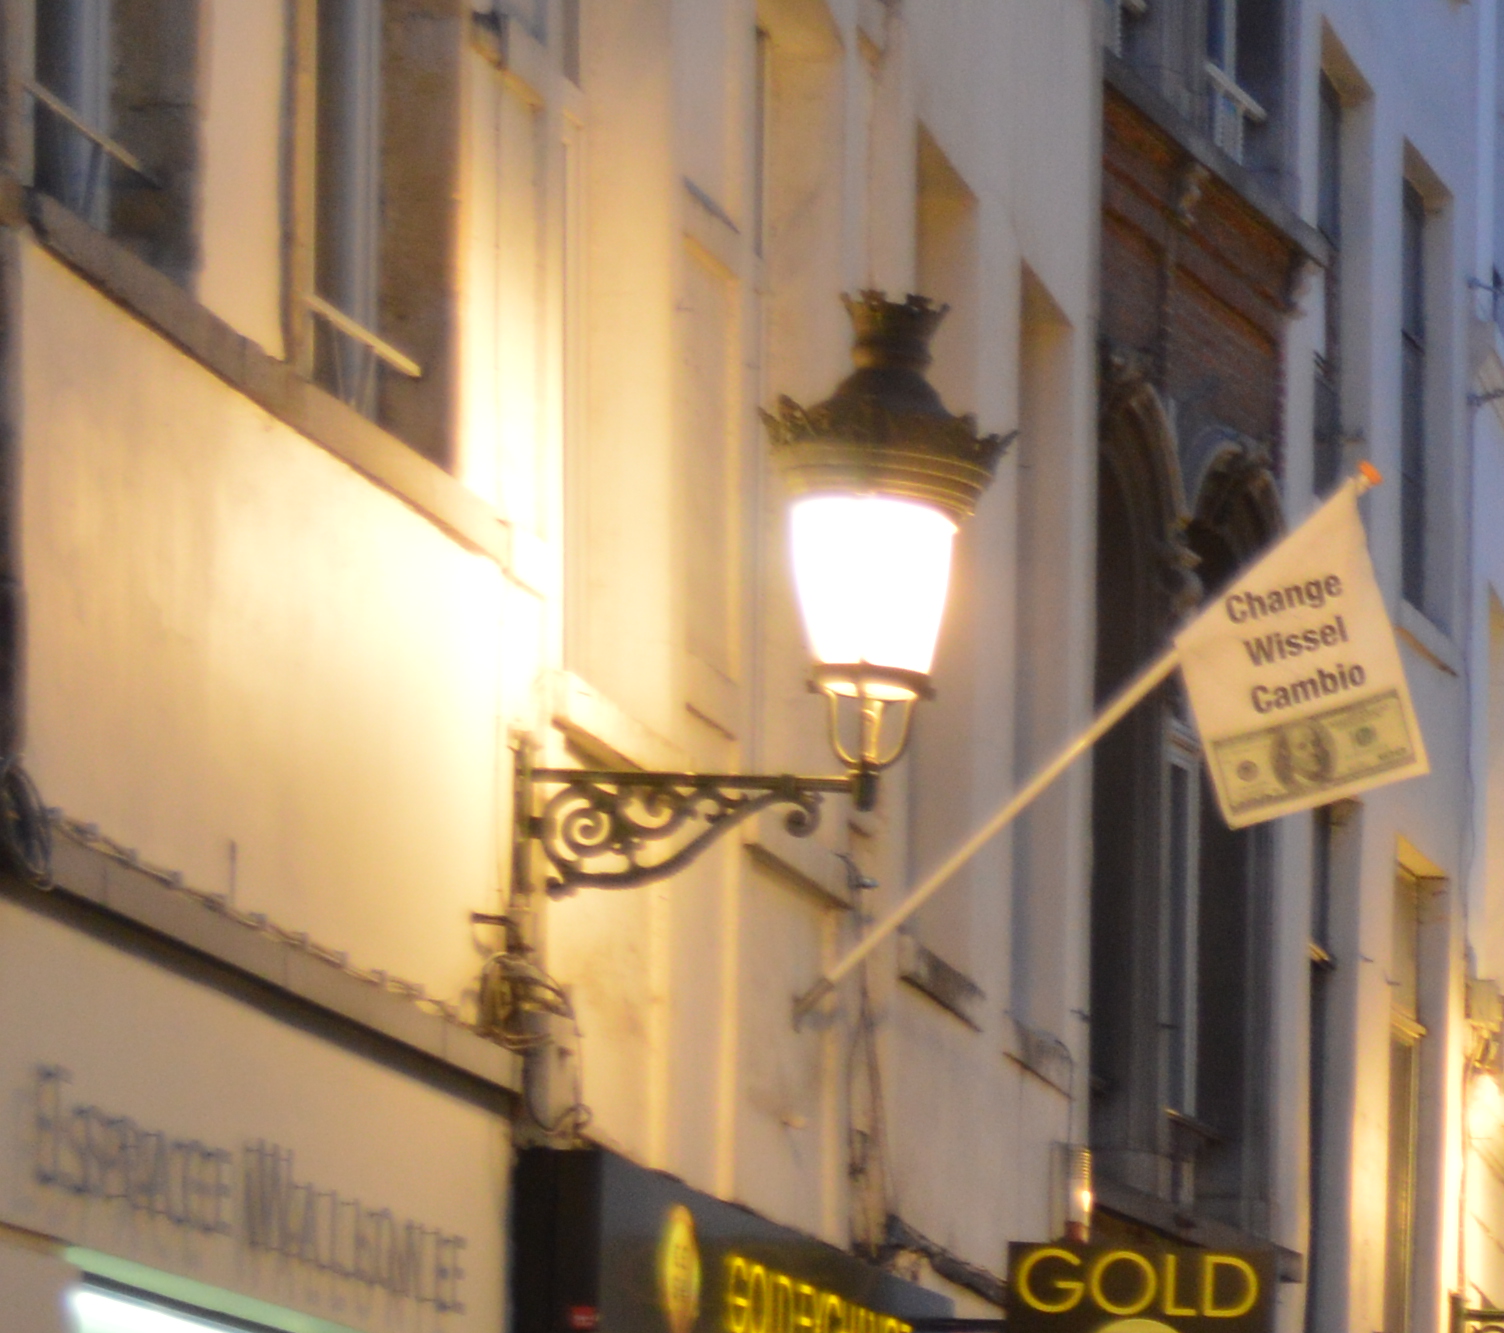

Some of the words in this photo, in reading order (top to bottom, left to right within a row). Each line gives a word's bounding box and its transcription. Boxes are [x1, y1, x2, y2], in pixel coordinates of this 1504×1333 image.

[1225, 574, 1343, 624] Change
[1243, 614, 1349, 667] Wissel
[1250, 663, 1367, 714] Cambio
[1018, 1248, 1259, 1318] GOLD
